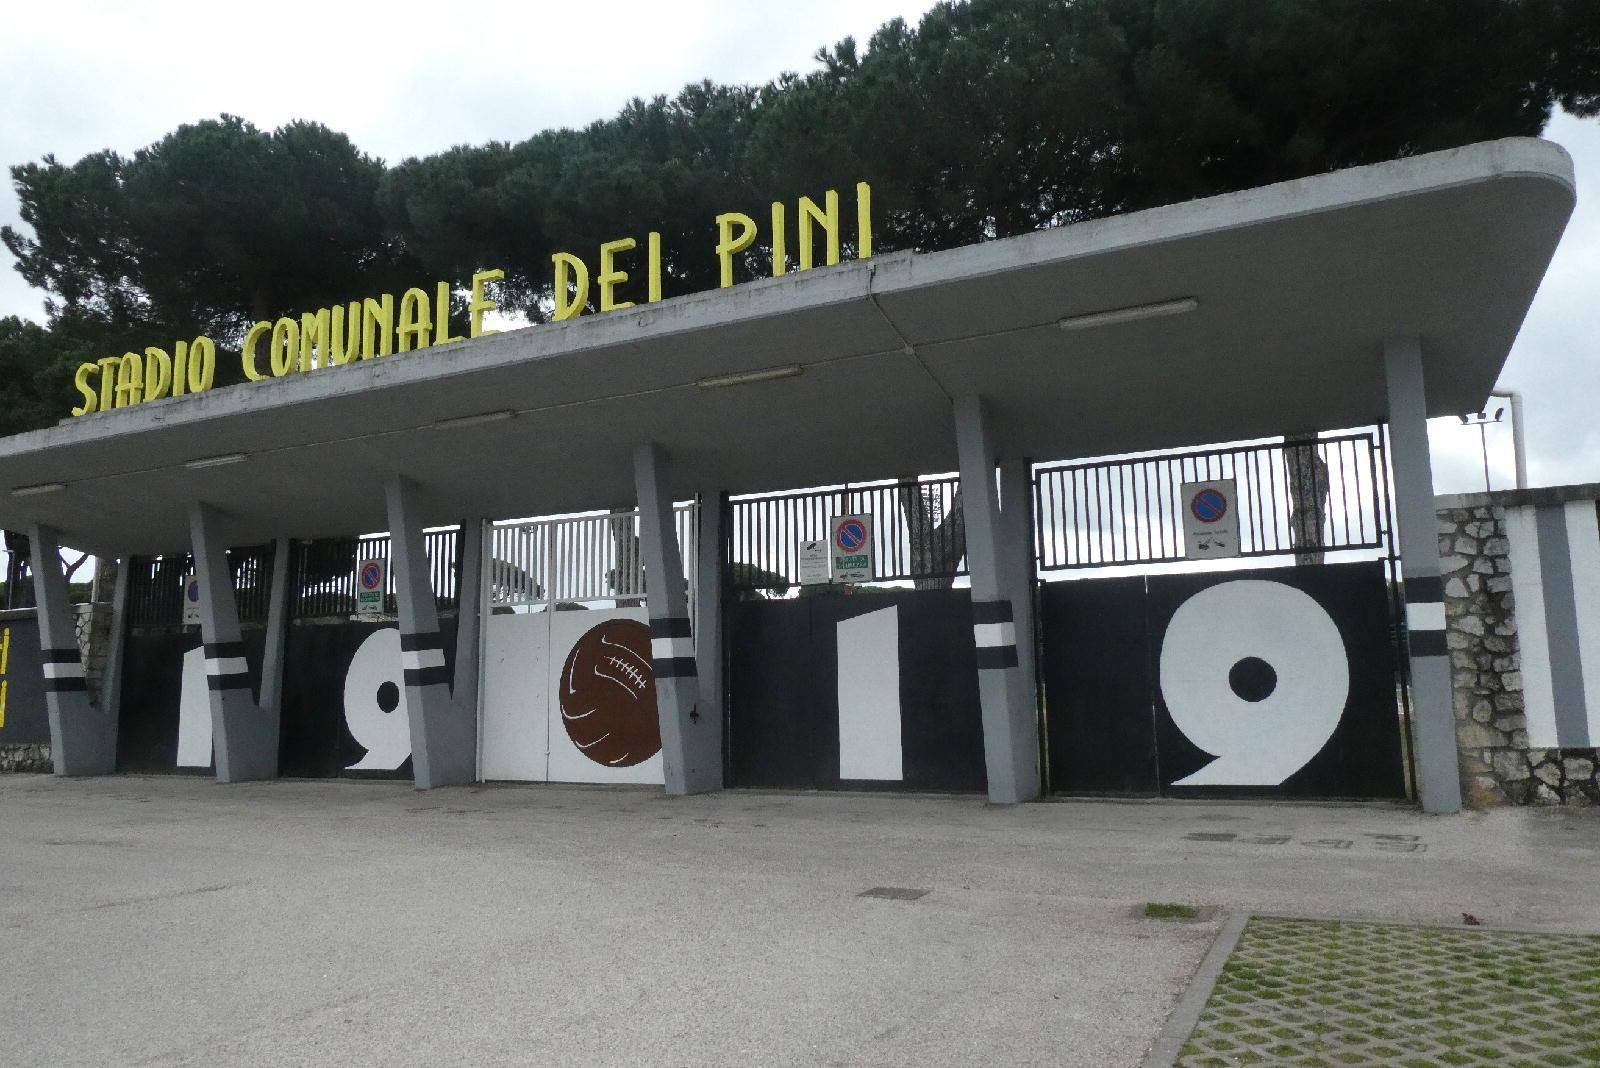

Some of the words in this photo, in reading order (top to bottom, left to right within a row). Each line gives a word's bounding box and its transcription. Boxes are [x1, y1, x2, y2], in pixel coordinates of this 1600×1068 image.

[71, 336, 215, 417] STADIO
[242, 269, 504, 381] COMUNALE
[551, 232, 661, 321] DEI
[716, 181, 871, 289] PINI
[837, 604, 904, 781] 1
[1160, 579, 1350, 786] 9
